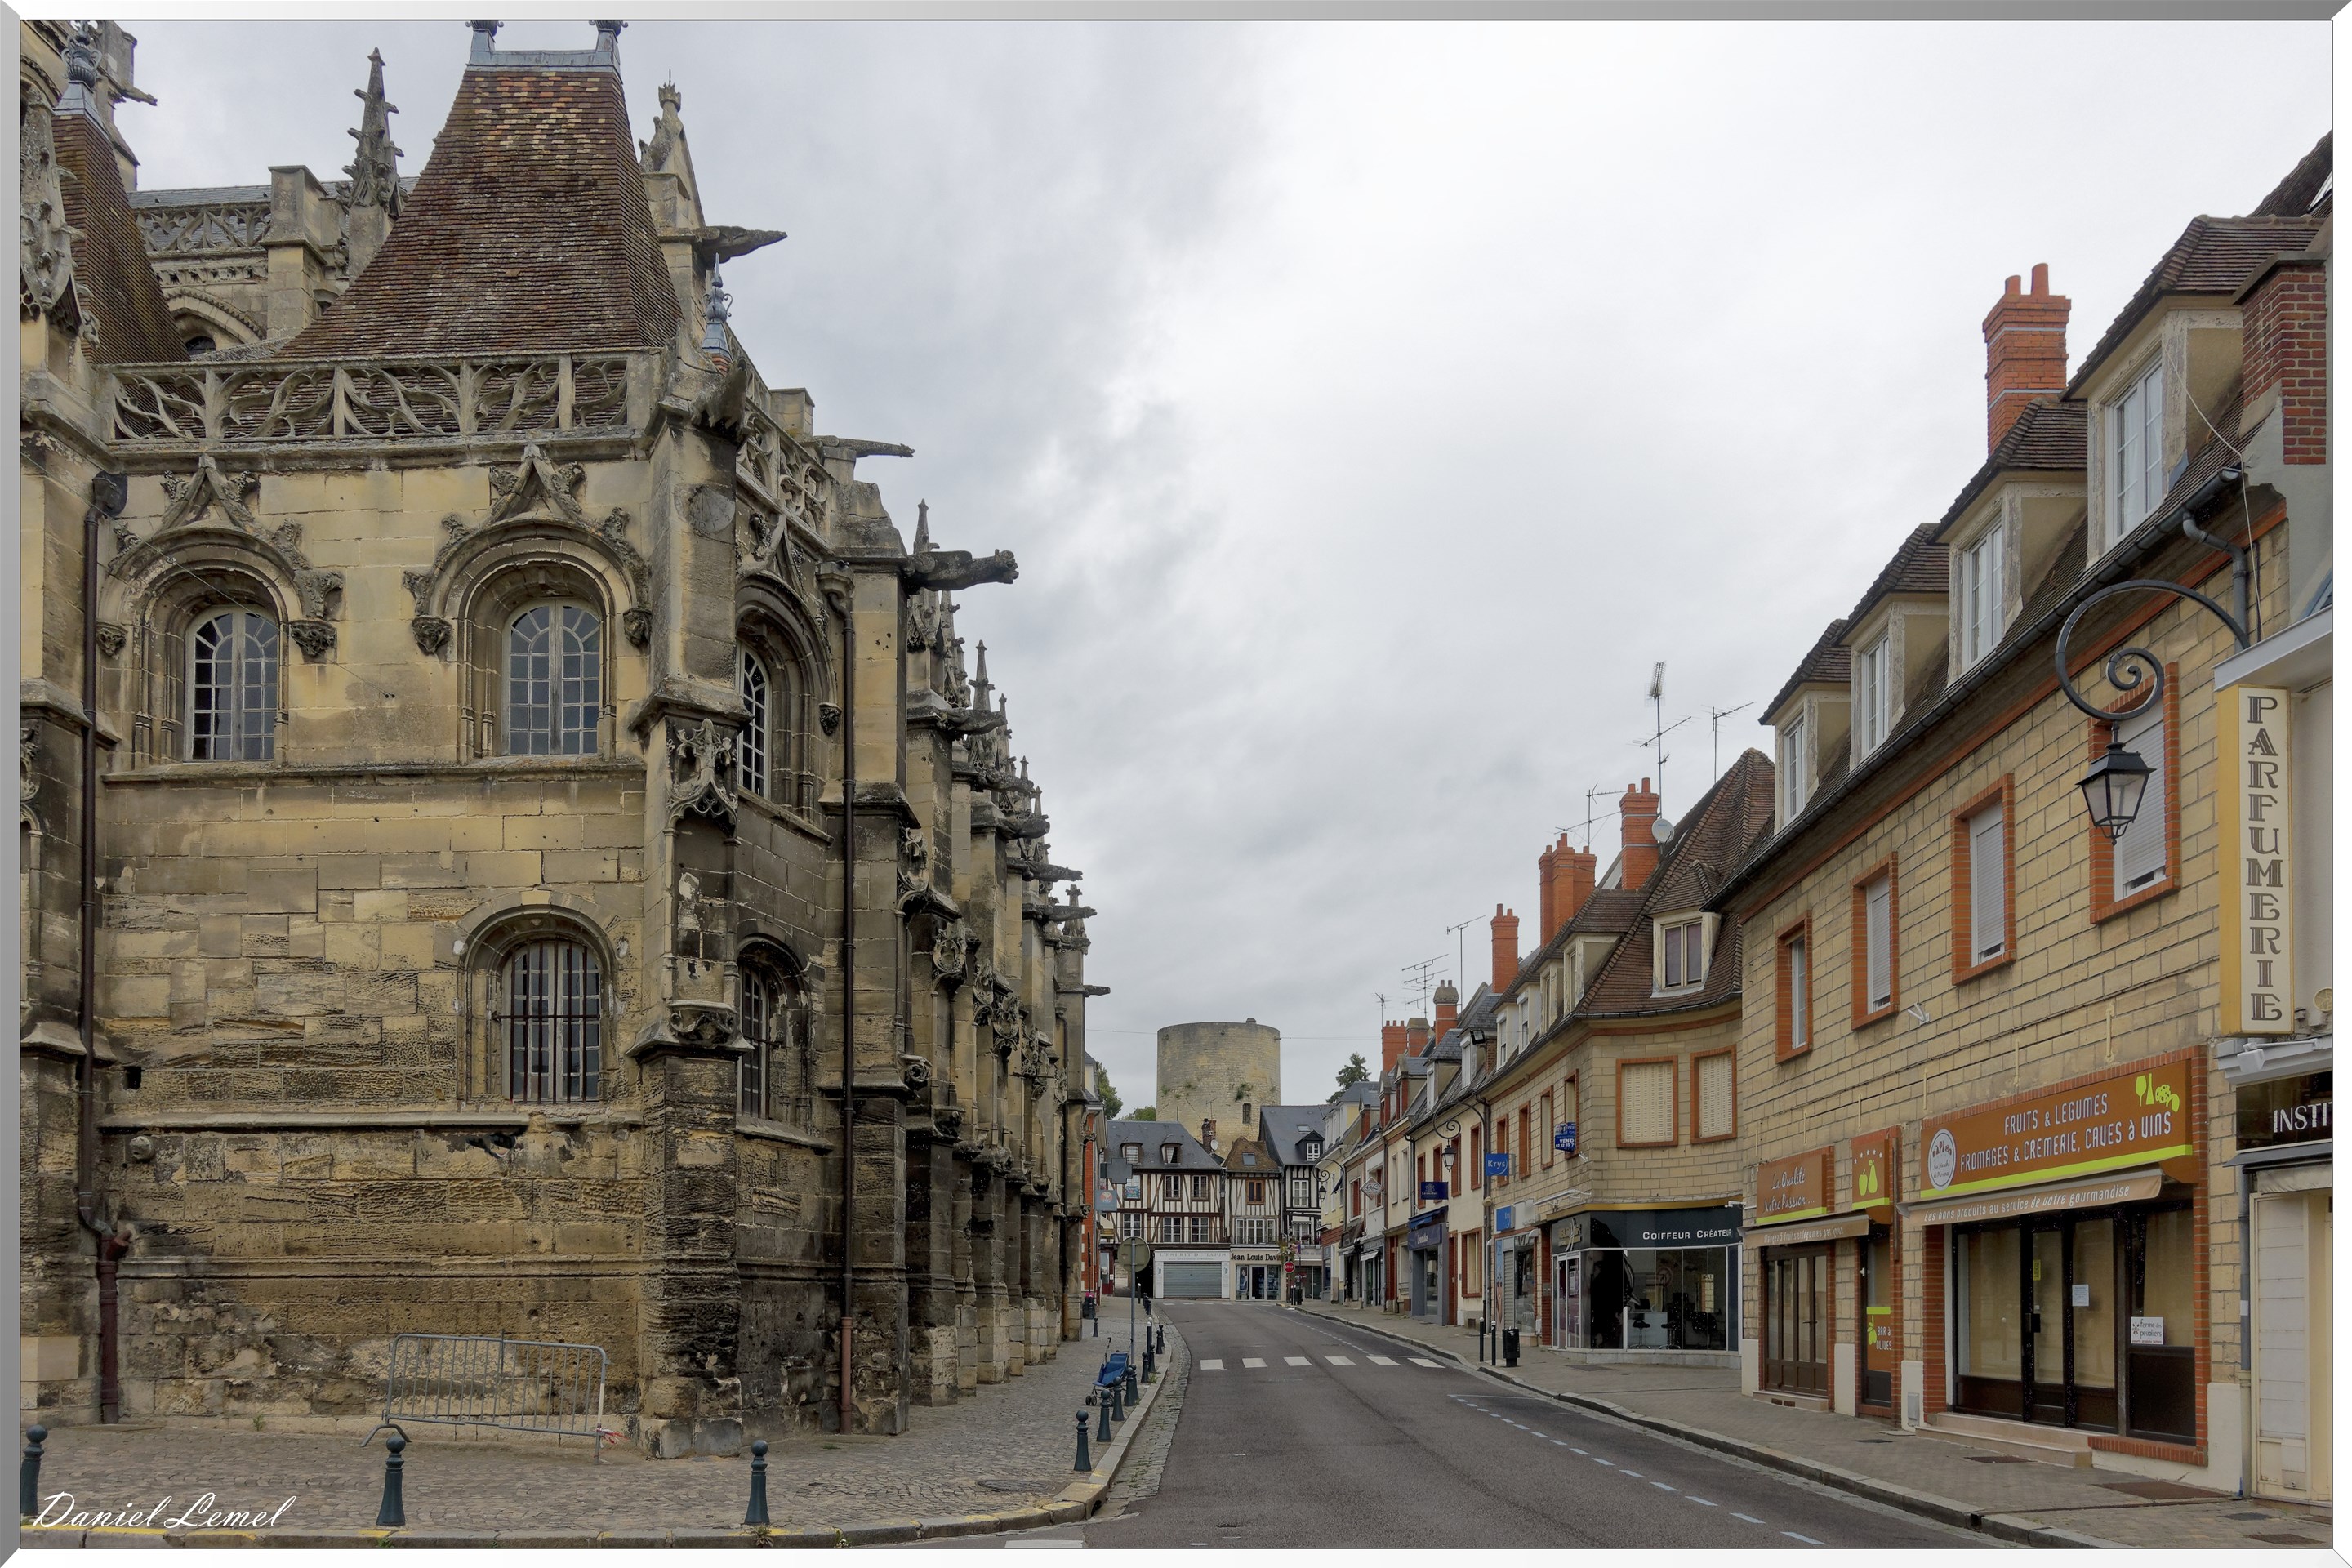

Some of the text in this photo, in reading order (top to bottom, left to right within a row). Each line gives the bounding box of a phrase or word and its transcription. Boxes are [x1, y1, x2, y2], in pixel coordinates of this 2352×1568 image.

[2246, 696, 2283, 1021] PARFUMERIE
[2004, 1092, 2109, 1136] FRUITS & LEGUMES
[1960, 1145, 2009, 1173] FROMAGES
[2013, 1145, 2020, 1161] &
[2023, 1131, 2081, 1160] CREMERIE,
[2085, 1121, 2122, 1150] CAVES
[2127, 1122, 2136, 1142] à
[2140, 1111, 2172, 1139] VINS
[1487, 1160, 1506, 1169] Krys
[1771, 1166, 1805, 1190] La Qualité
[1765, 1195, 1780, 1212] Notre
[1924, 1184, 2131, 1222] Les bons produits au service de votre gourmandise
[1764, 1233, 1779, 1244] Mangez
[1780, 1232, 1783, 1241] 5
[1784, 1231, 1796, 1241] fruits
[1797, 1230, 1802, 1240] et
[1802, 1229, 1822, 1240] légumes
[1832, 1226, 1844, 1238] jour
[1877, 1326, 1886, 1336] BAR
[2140, 1319, 2155, 1329] ferme
[2140, 1329, 2163, 1339] peupliers
[1876, 1340, 1892, 1350] OLIVES
